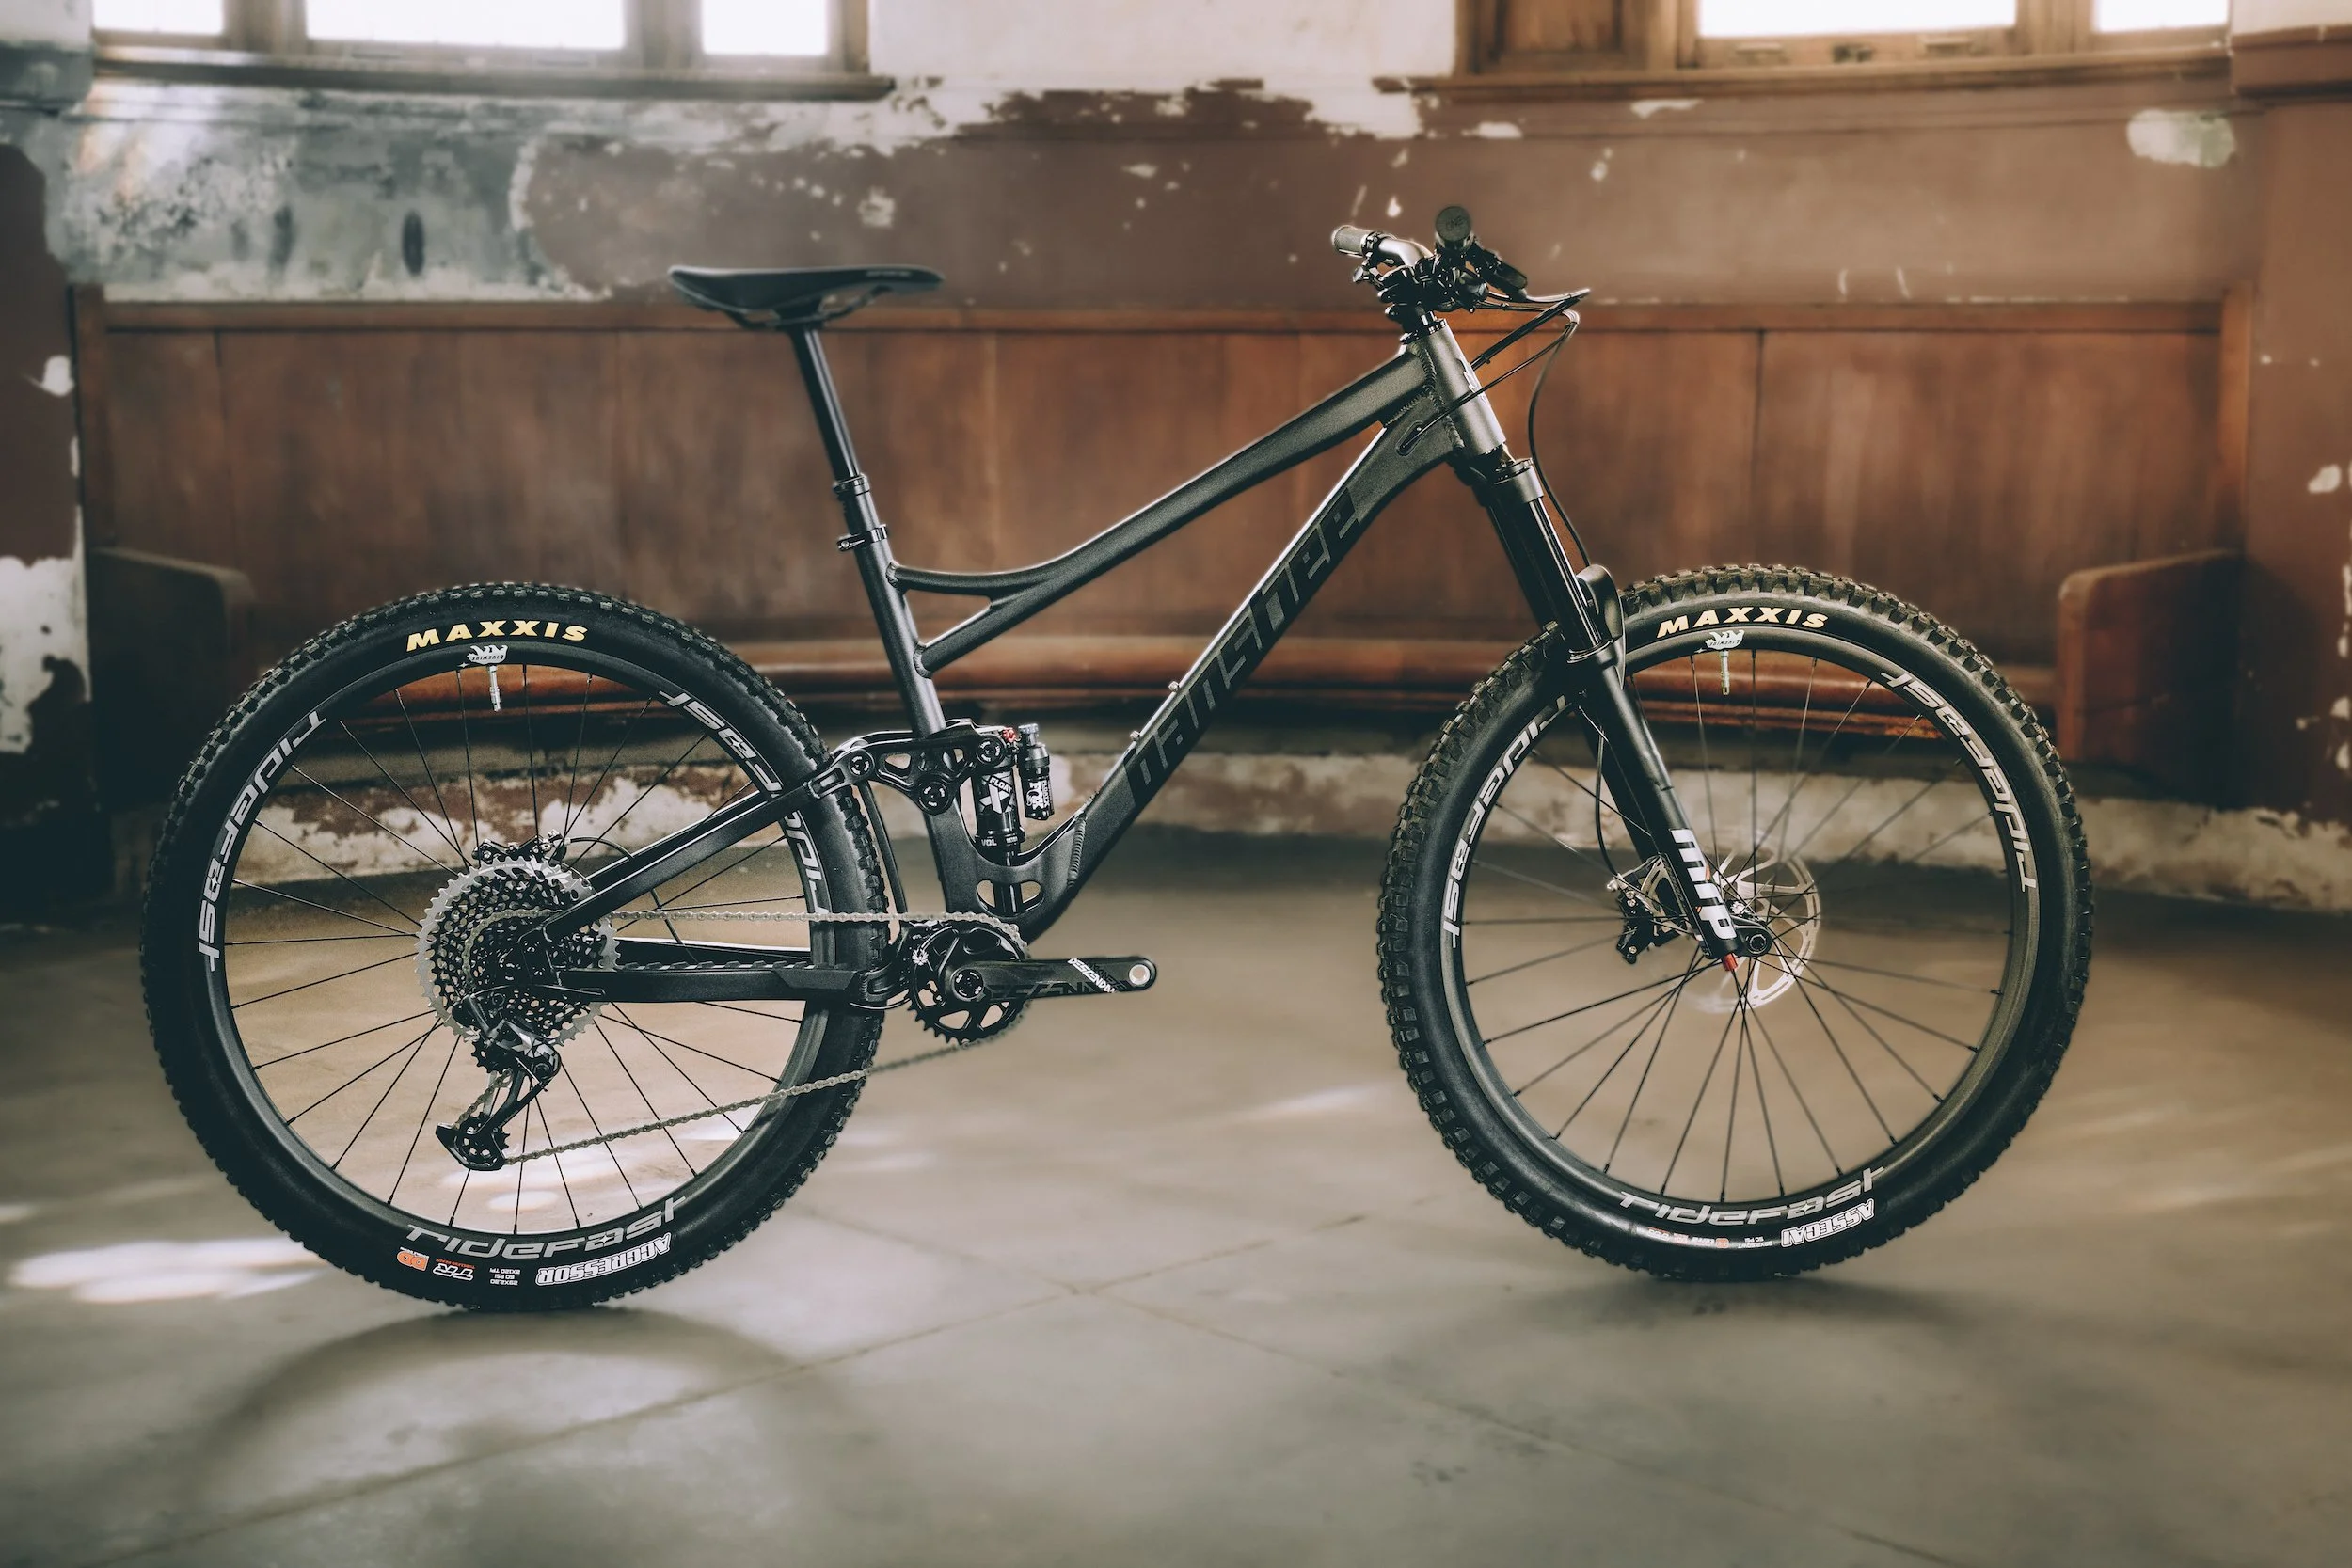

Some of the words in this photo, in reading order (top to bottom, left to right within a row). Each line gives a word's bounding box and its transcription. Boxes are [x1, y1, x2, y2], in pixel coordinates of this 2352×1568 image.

[405, 619, 588, 652] MAXXIS
[1656, 606, 1829, 639] MAXXIS
[989, 775, 1013, 794] FLOAT
[1026, 782, 1043, 810] FOX
[1781, 1198, 1874, 1247] ASSEGAI
[535, 1232, 672, 1286] AGGRESSOR
